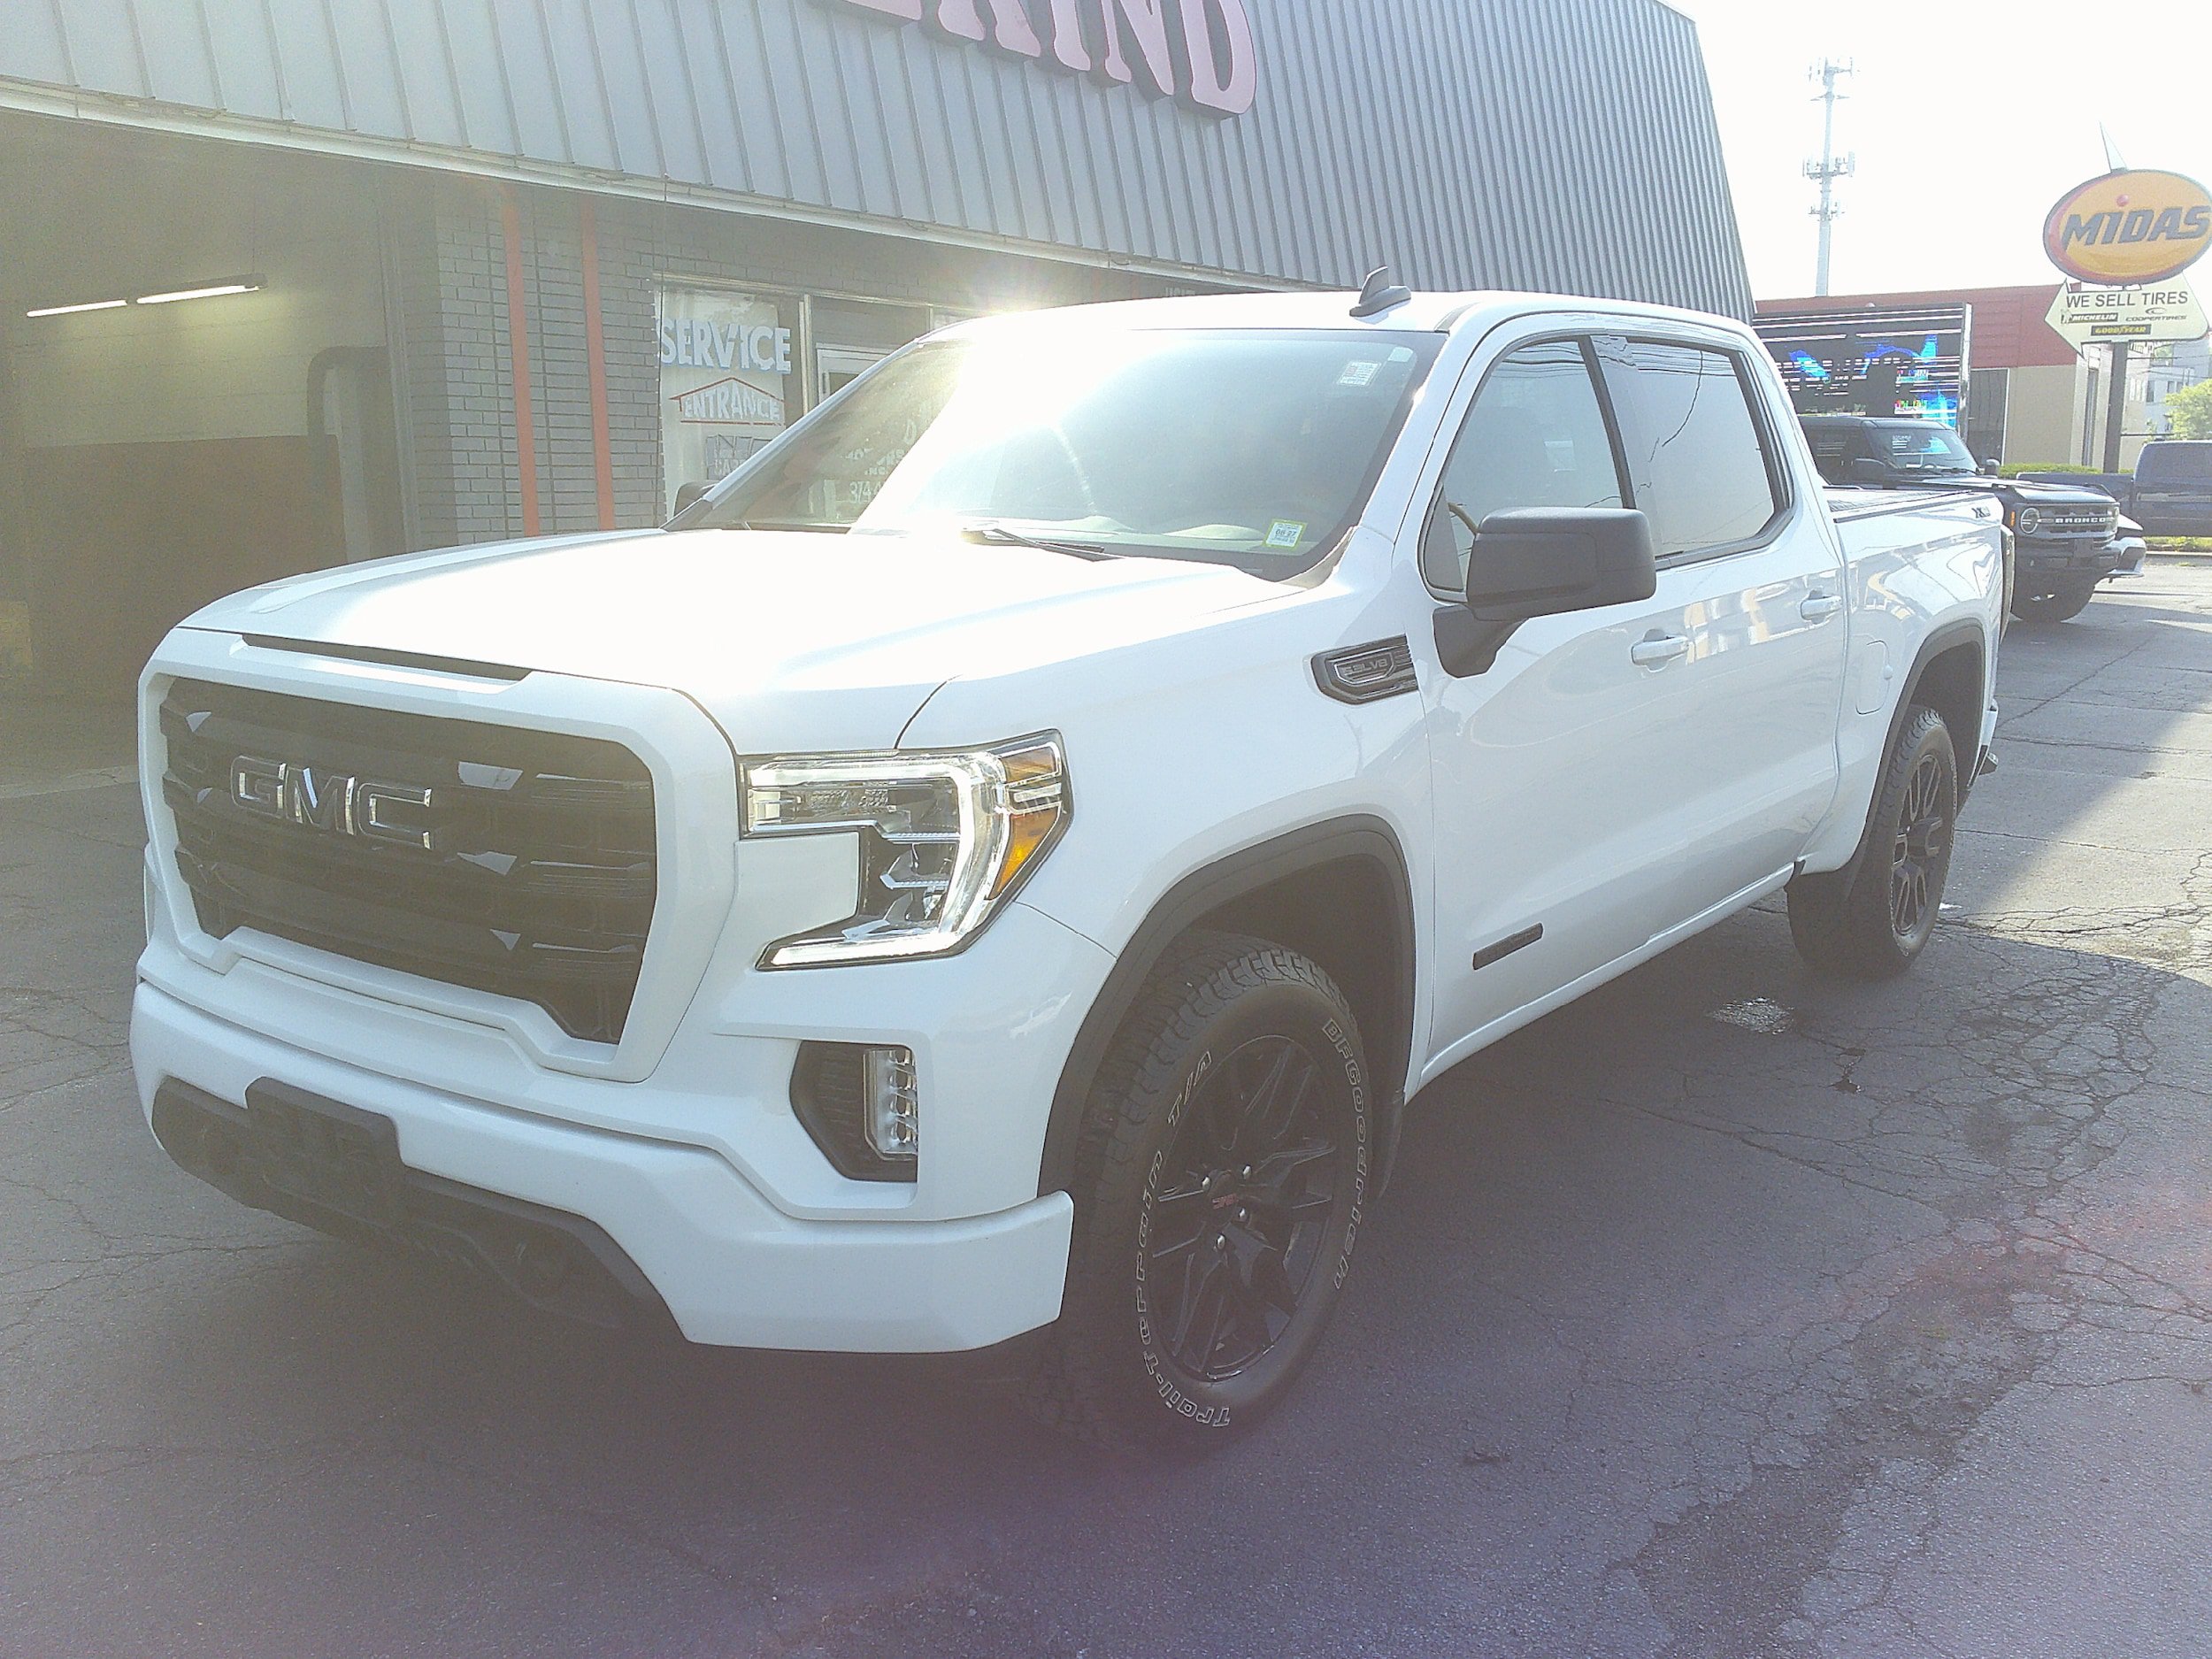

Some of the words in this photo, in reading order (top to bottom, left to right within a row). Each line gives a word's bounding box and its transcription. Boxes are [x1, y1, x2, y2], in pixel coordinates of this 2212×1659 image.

[2061, 205, 2211, 252] MIDAS
[2066, 295, 2091, 308] WE
[2094, 293, 2136, 307] SELL
[2141, 291, 2188, 305] TIRES
[2071, 312, 2117, 322] MICHELIN
[656, 319, 792, 374] SERVICE
[2094, 326, 2147, 334] GOODYEAR
[684, 382, 780, 421] ENTRANCE
[230, 755, 433, 850] GMC
[1322, 1018, 1368, 1290] BFGoodrich
